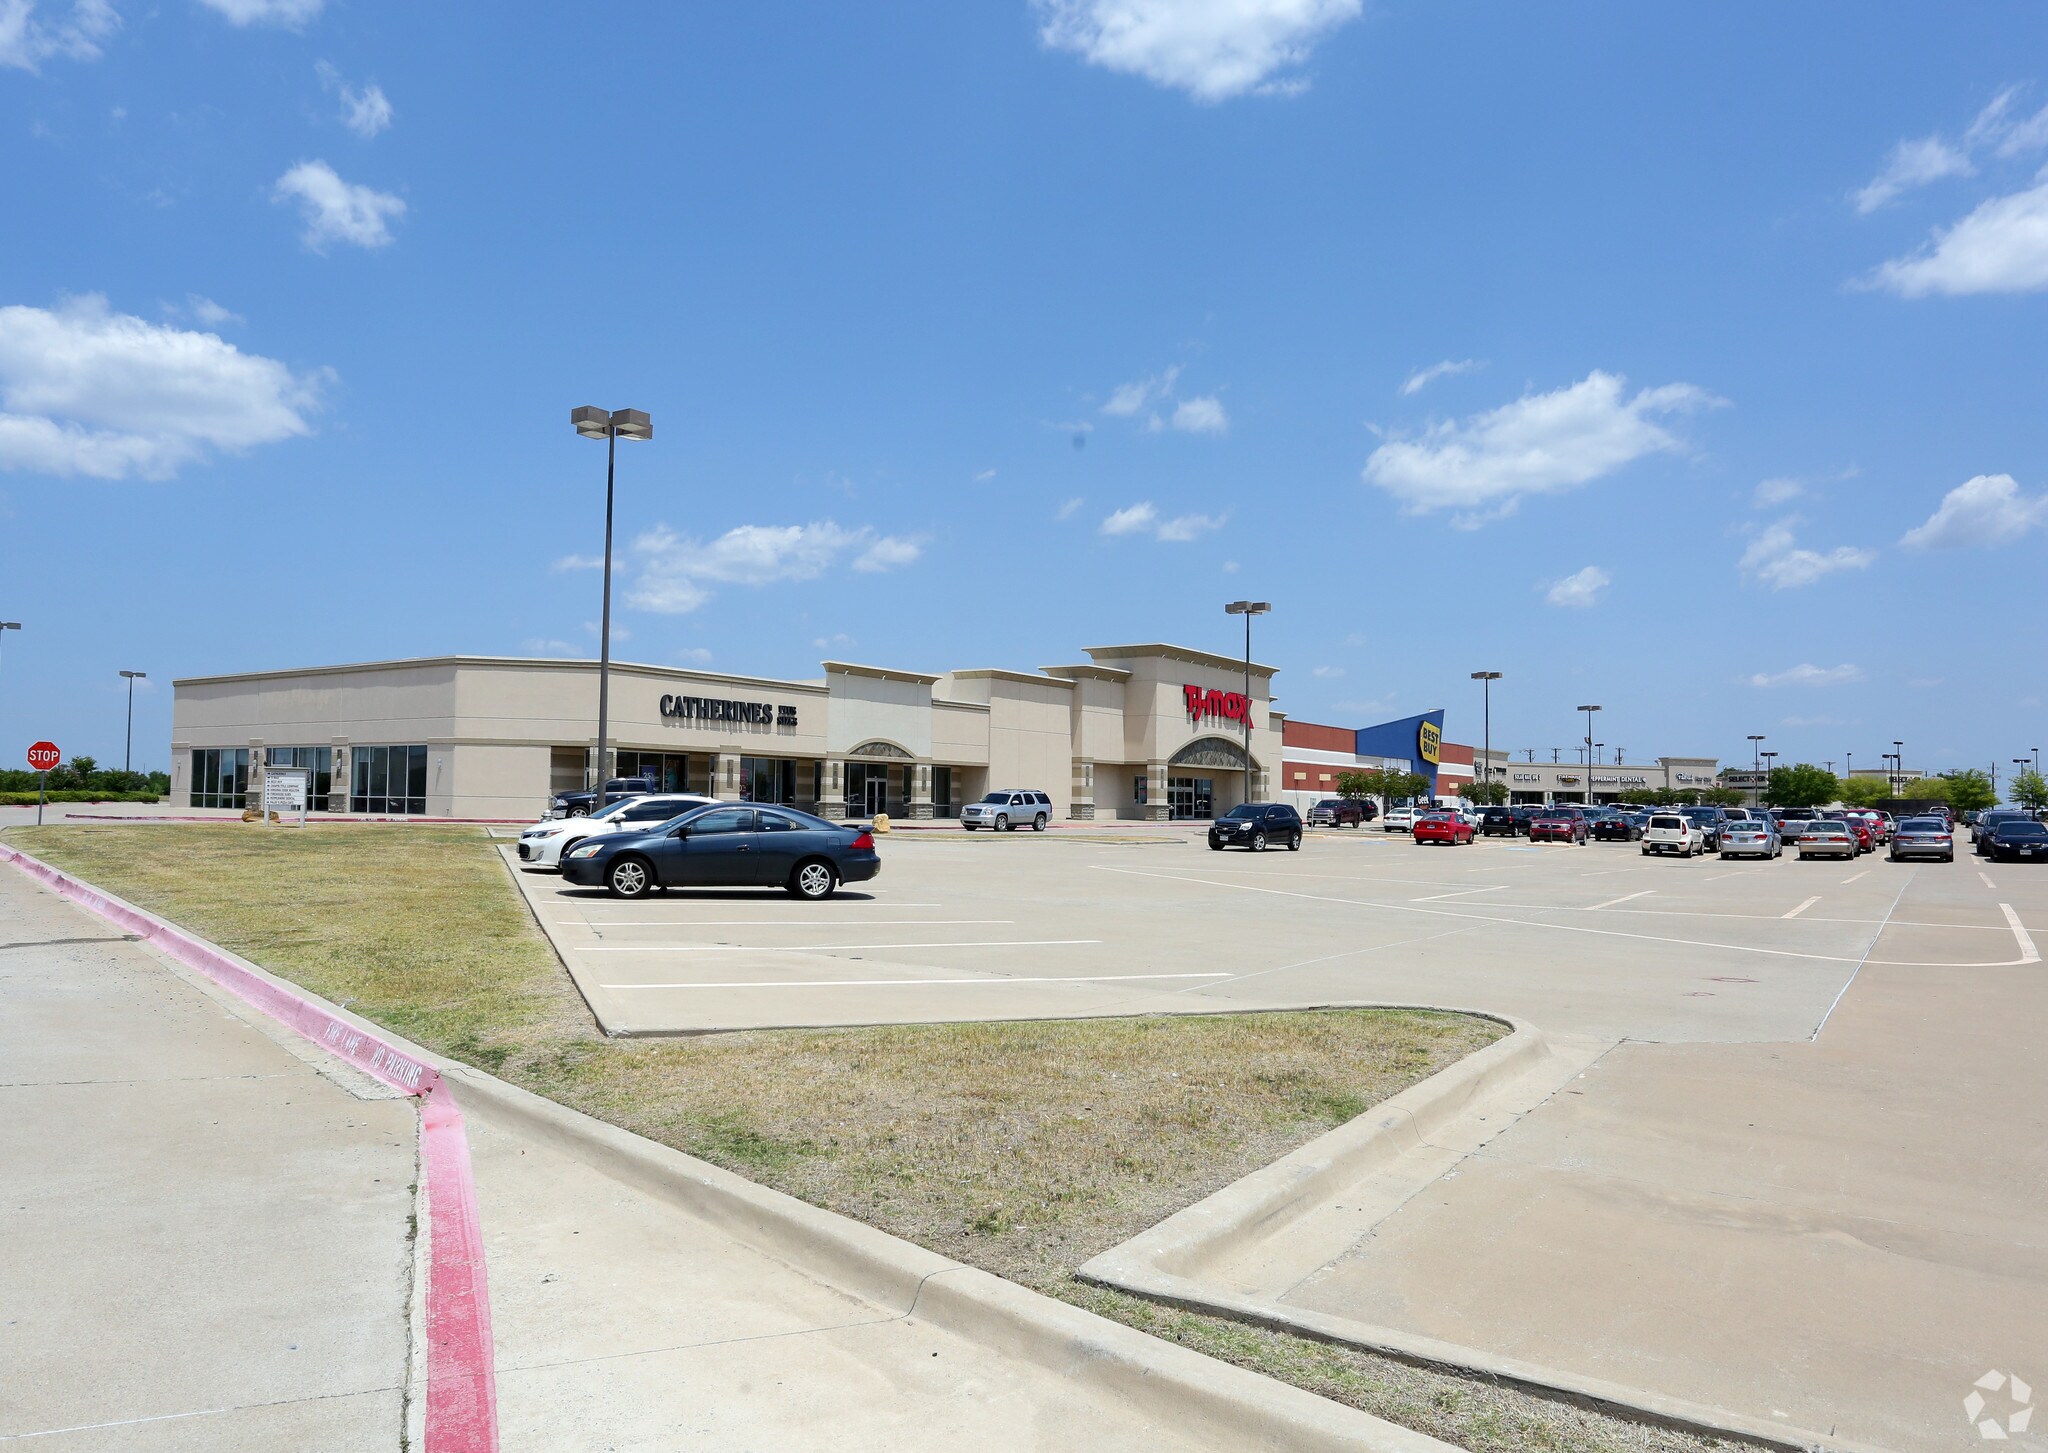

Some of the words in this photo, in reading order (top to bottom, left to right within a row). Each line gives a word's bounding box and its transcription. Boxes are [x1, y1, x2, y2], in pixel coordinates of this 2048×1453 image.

[660, 694, 773, 725] CATHERINES
[1423, 727, 1439, 744] BEST
[29, 750, 59, 762] STOP
[1423, 741, 1437, 757] BUY
[370, 1046, 386, 1069] NO
[382, 1052, 423, 1089] PARKING
